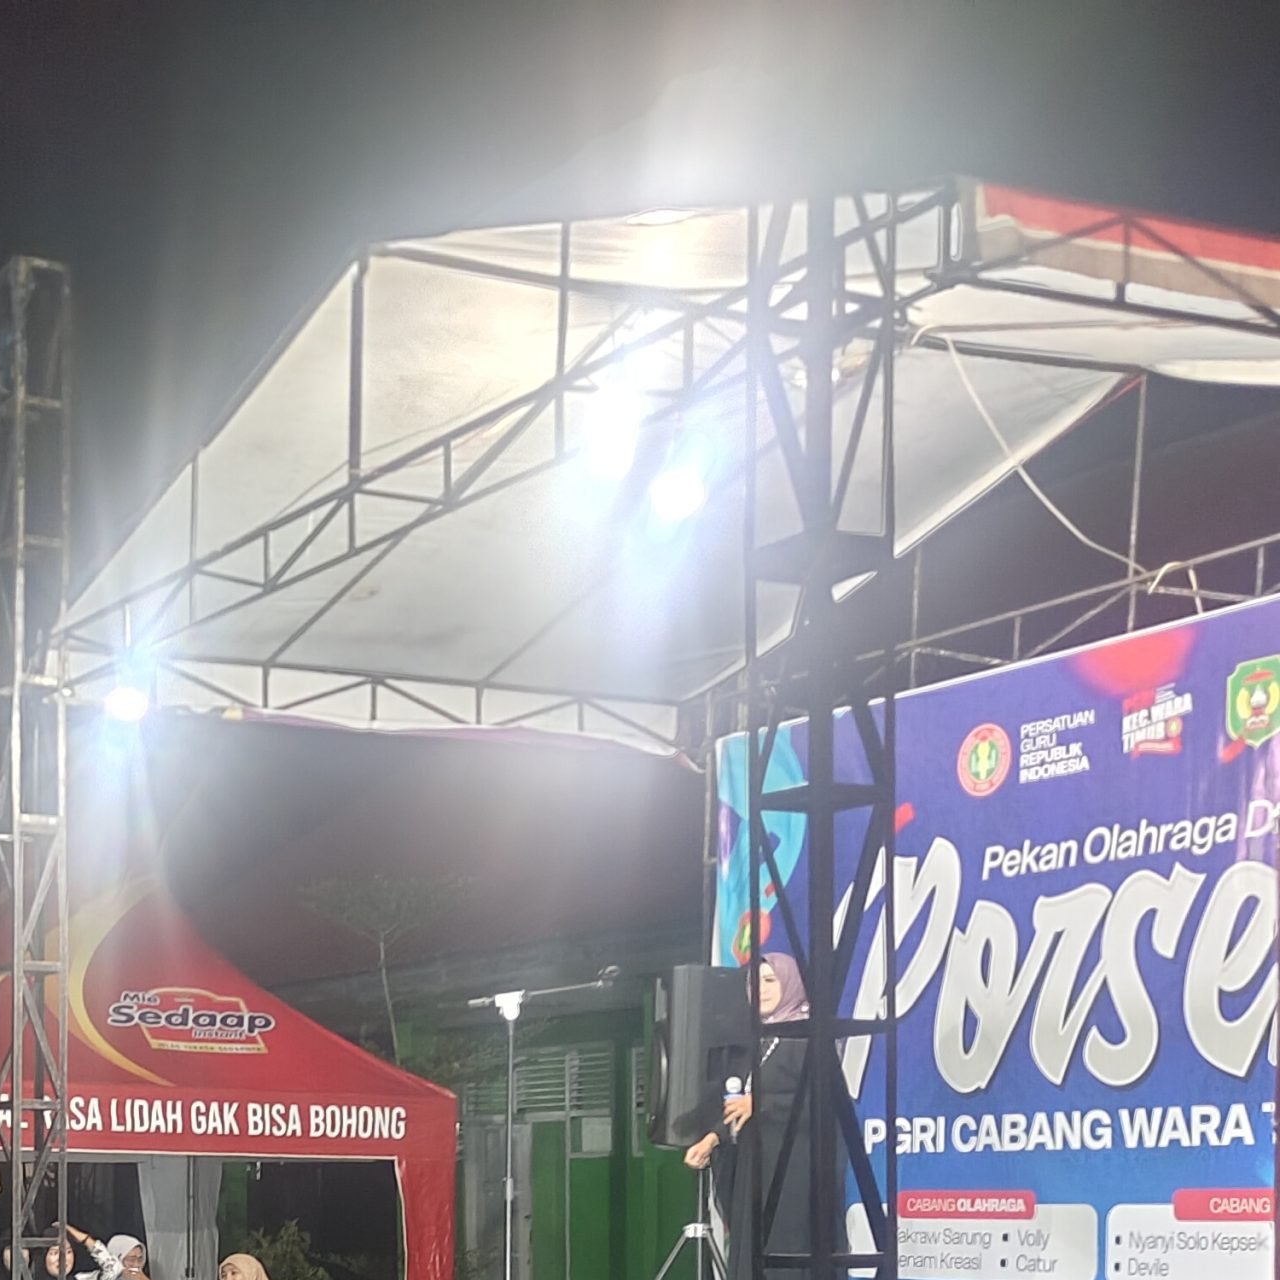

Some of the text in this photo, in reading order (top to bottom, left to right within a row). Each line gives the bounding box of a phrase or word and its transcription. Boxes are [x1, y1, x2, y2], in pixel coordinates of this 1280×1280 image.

[1020, 709, 1095, 738] PERSATUAN
[1020, 734, 1057, 752] GURU
[1019, 742, 1083, 769] REPUBLIK
[1019, 756, 1090, 784] INDONESIA
[981, 839, 1078, 881] Pekan
[1083, 811, 1238, 865] Olahraga
[107, 1003, 275, 1036] Sedaap
[110, 1098, 184, 1134] LIDAH
[190, 1100, 240, 1136] GAK
[246, 1102, 303, 1138] BISA
[309, 1104, 407, 1140] BOHONG
[864, 1115, 946, 1155] PGRI
[951, 1108, 1112, 1153] CABANG
[1119, 1103, 1255, 1149] WARA
[906, 1198, 1027, 1213] CABANG OLAHRAGA
[1209, 1197, 1271, 1214] CABANG
[897, 1227, 992, 1249] akraw Sarung
[1016, 1229, 1051, 1250] Volly
[1127, 1230, 1269, 1255] Nyanyi Solo Kepsek
[898, 1252, 983, 1270] enam Kreasi
[1015, 1254, 1058, 1273] Catur
[1127, 1257, 1170, 1276] Devile
